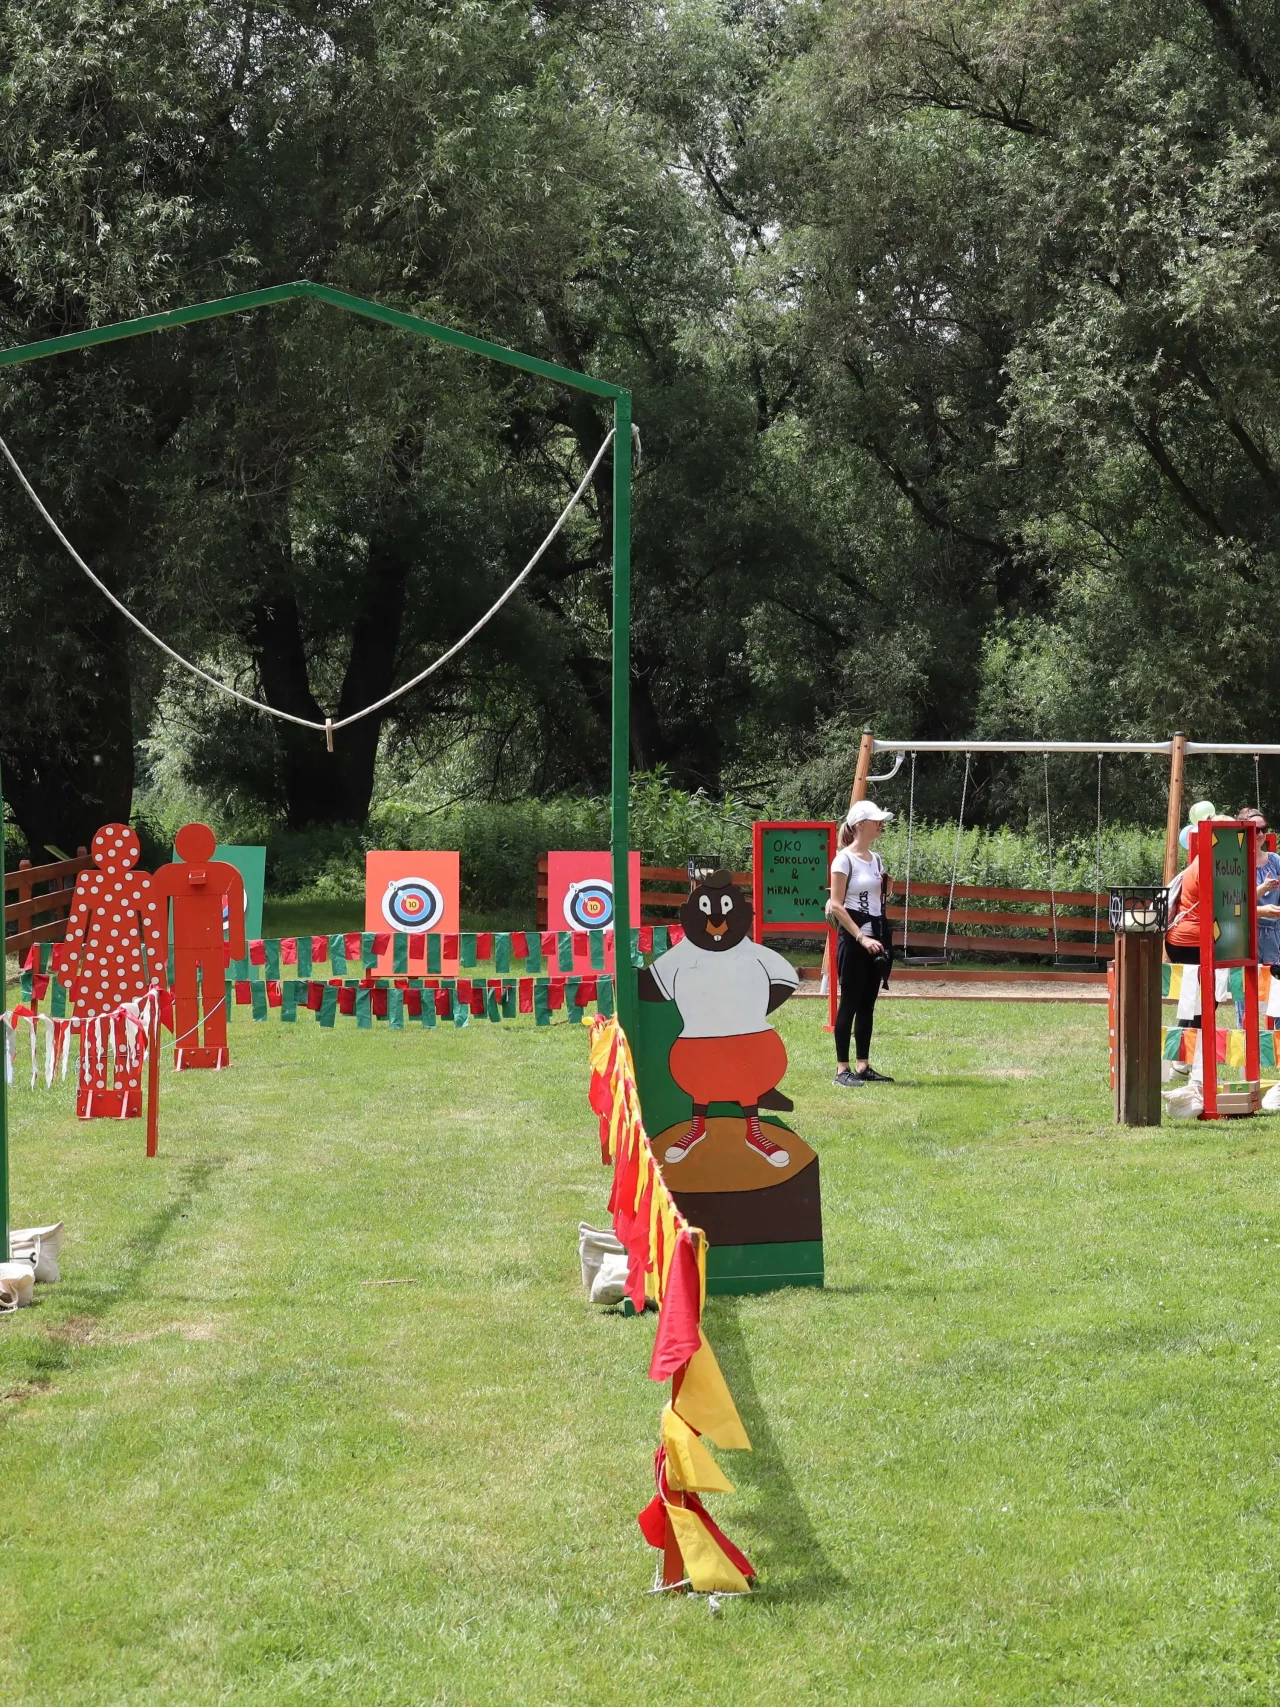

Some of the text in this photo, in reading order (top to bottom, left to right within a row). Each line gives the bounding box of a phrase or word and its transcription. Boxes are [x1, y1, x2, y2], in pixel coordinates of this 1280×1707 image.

[773, 839, 802, 852] OKO
[773, 856, 820, 865] SOKOLOVO
[791, 868, 799, 880] &
[793, 898, 819, 906] RUKA
